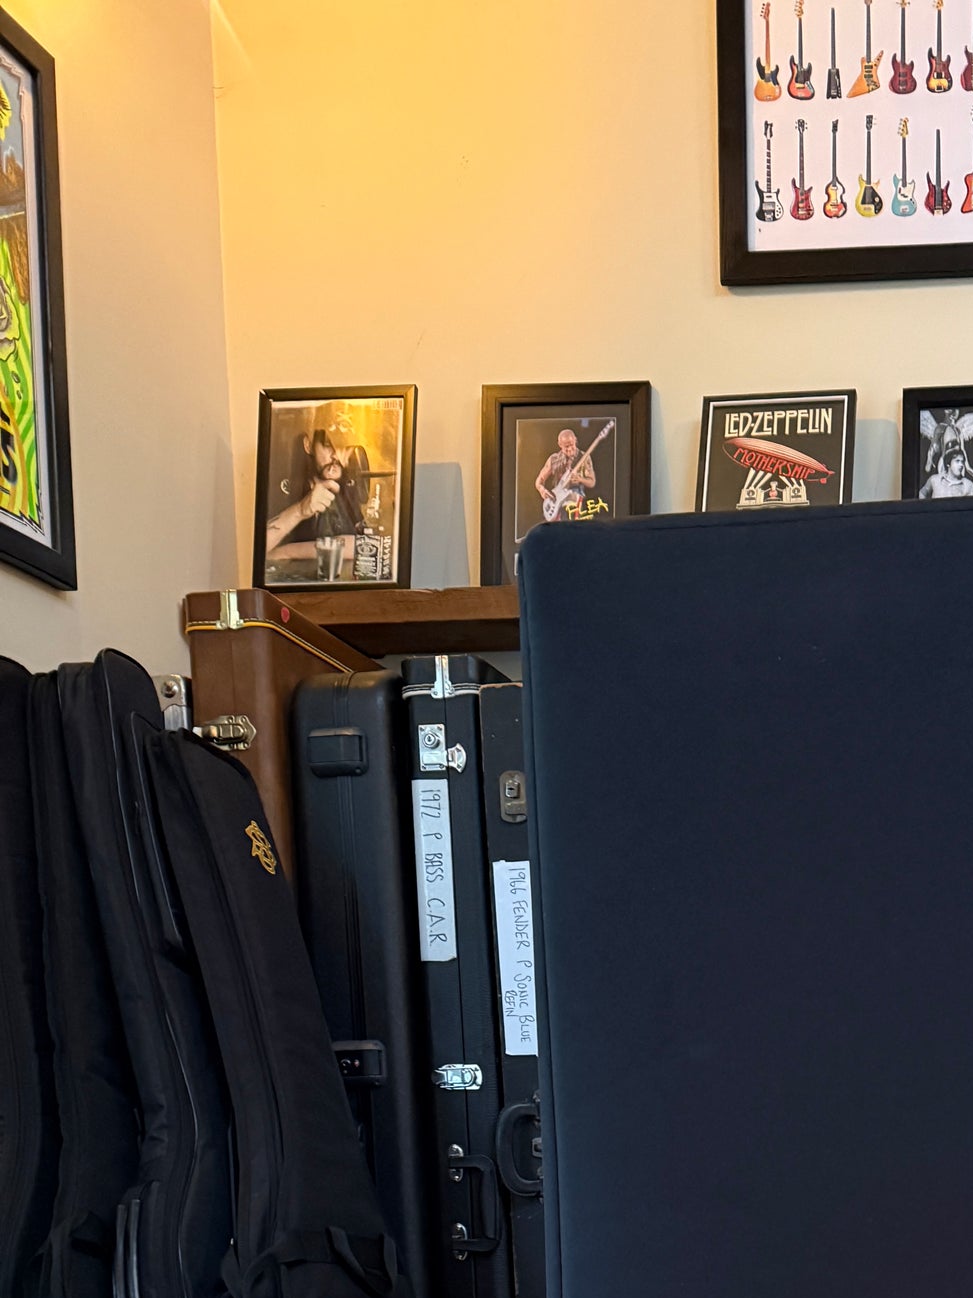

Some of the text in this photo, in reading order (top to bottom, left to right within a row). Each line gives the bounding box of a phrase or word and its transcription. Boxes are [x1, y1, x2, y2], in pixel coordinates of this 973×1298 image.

[732, 447, 816, 480] MOTHERSHIP
[420, 788, 442, 819] 1972
[423, 832, 443, 840] P
[425, 852, 444, 883] BASS
[508, 867, 536, 1043] 1966 FENDER P SONIC BLUE
